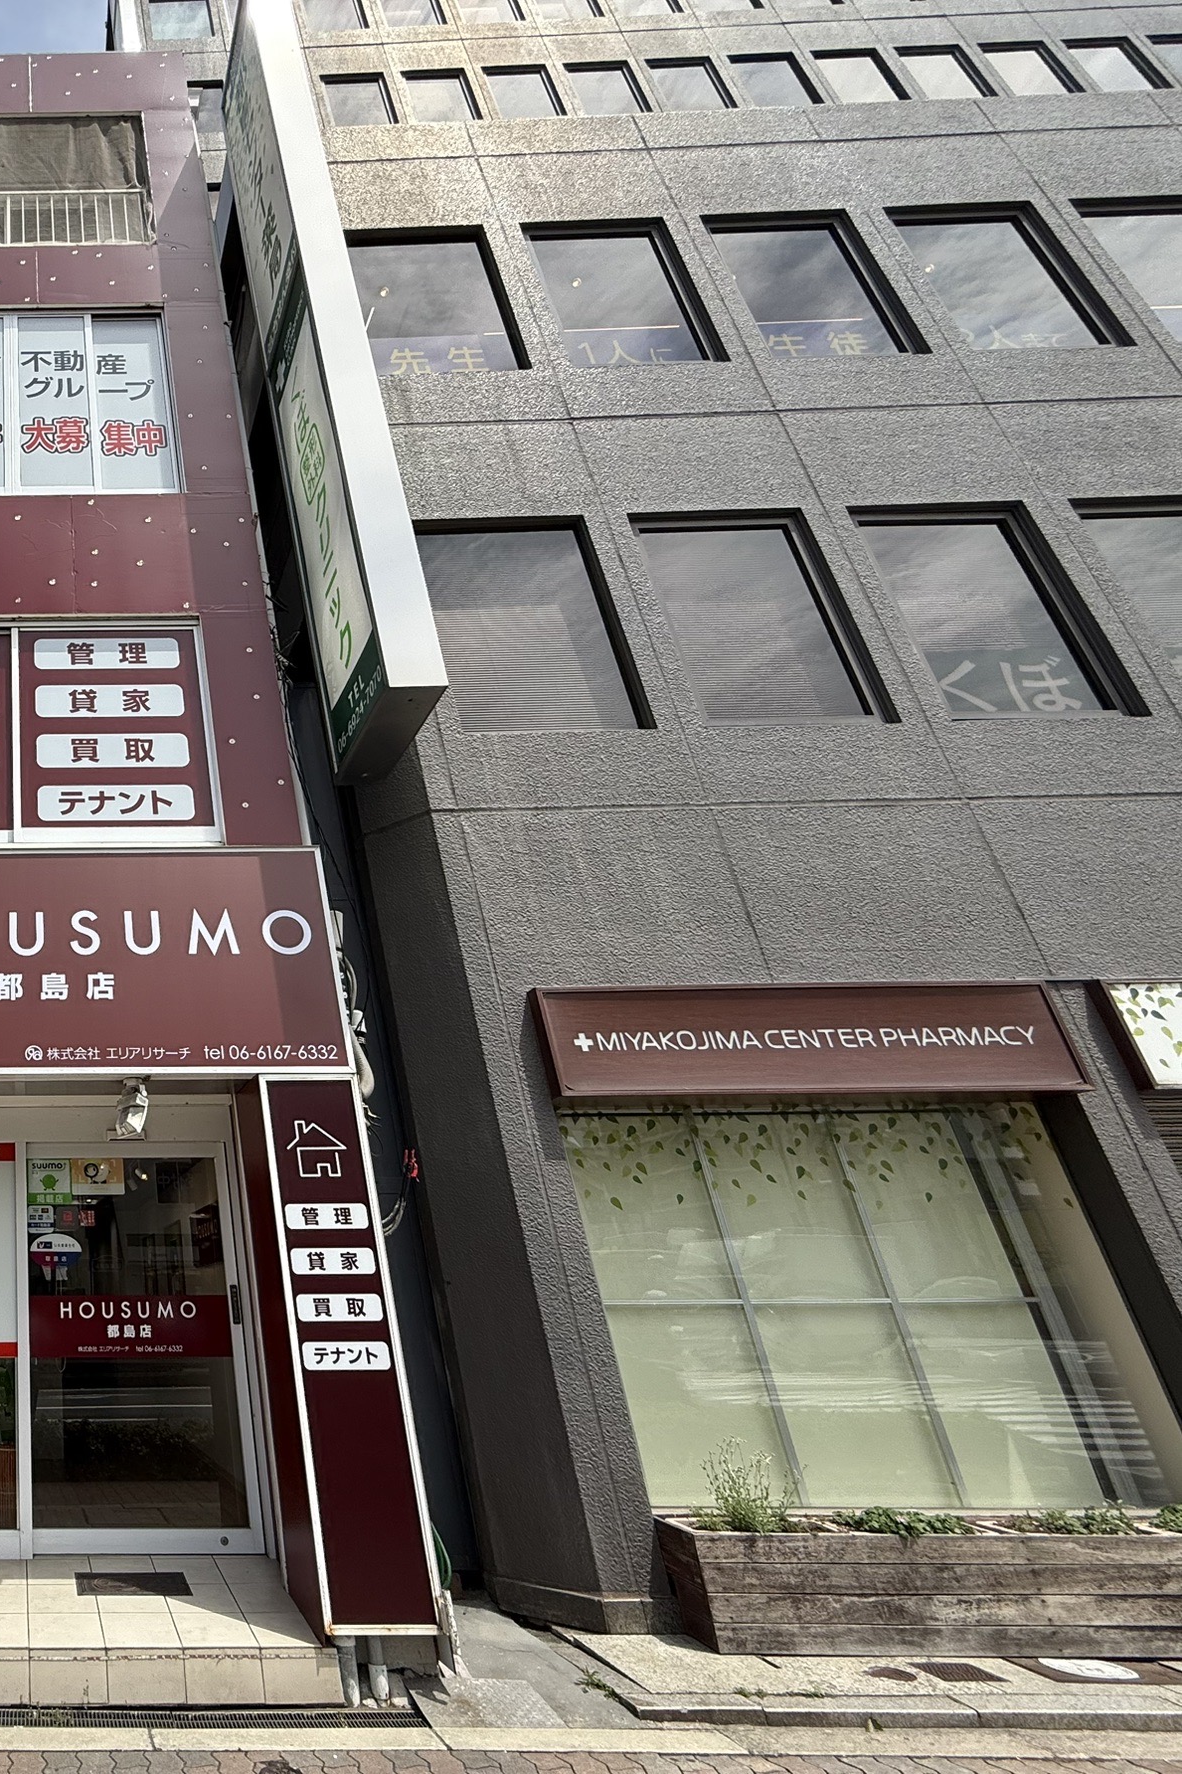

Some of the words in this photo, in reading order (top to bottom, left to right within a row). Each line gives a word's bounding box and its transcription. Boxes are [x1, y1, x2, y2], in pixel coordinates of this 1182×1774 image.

[389, 346, 489, 374] 先生
[315, 481, 352, 670] クリニック
[67, 642, 147, 665] 管理
[348, 675, 365, 708] TEL
[940, 654, 1082, 712] くぼ
[68, 689, 151, 713] 貸家
[338, 665, 382, 754] 06-6924-7070
[70, 738, 155, 763] 買取
[58, 791, 173, 815] テナント
[597, 1029, 762, 1052] MIYAKOJIMA
[763, 1029, 877, 1050] CENTER
[879, 1025, 1036, 1048] PHARMACY
[47, 1046, 101, 1060] 株式会社
[106, 1047, 191, 1060] エリアリサーチ
[204, 1045, 225, 1060] tel
[229, 1045, 338, 1060] 06-6167-6332
[301, 1207, 353, 1225] 管理
[306, 1252, 359, 1271] 貸家
[60, 1301, 196, 1319] HOUSUMO
[313, 1298, 367, 1317] 買取
[107, 1324, 152, 1338] 都島店
[314, 1347, 378, 1365] テナント
